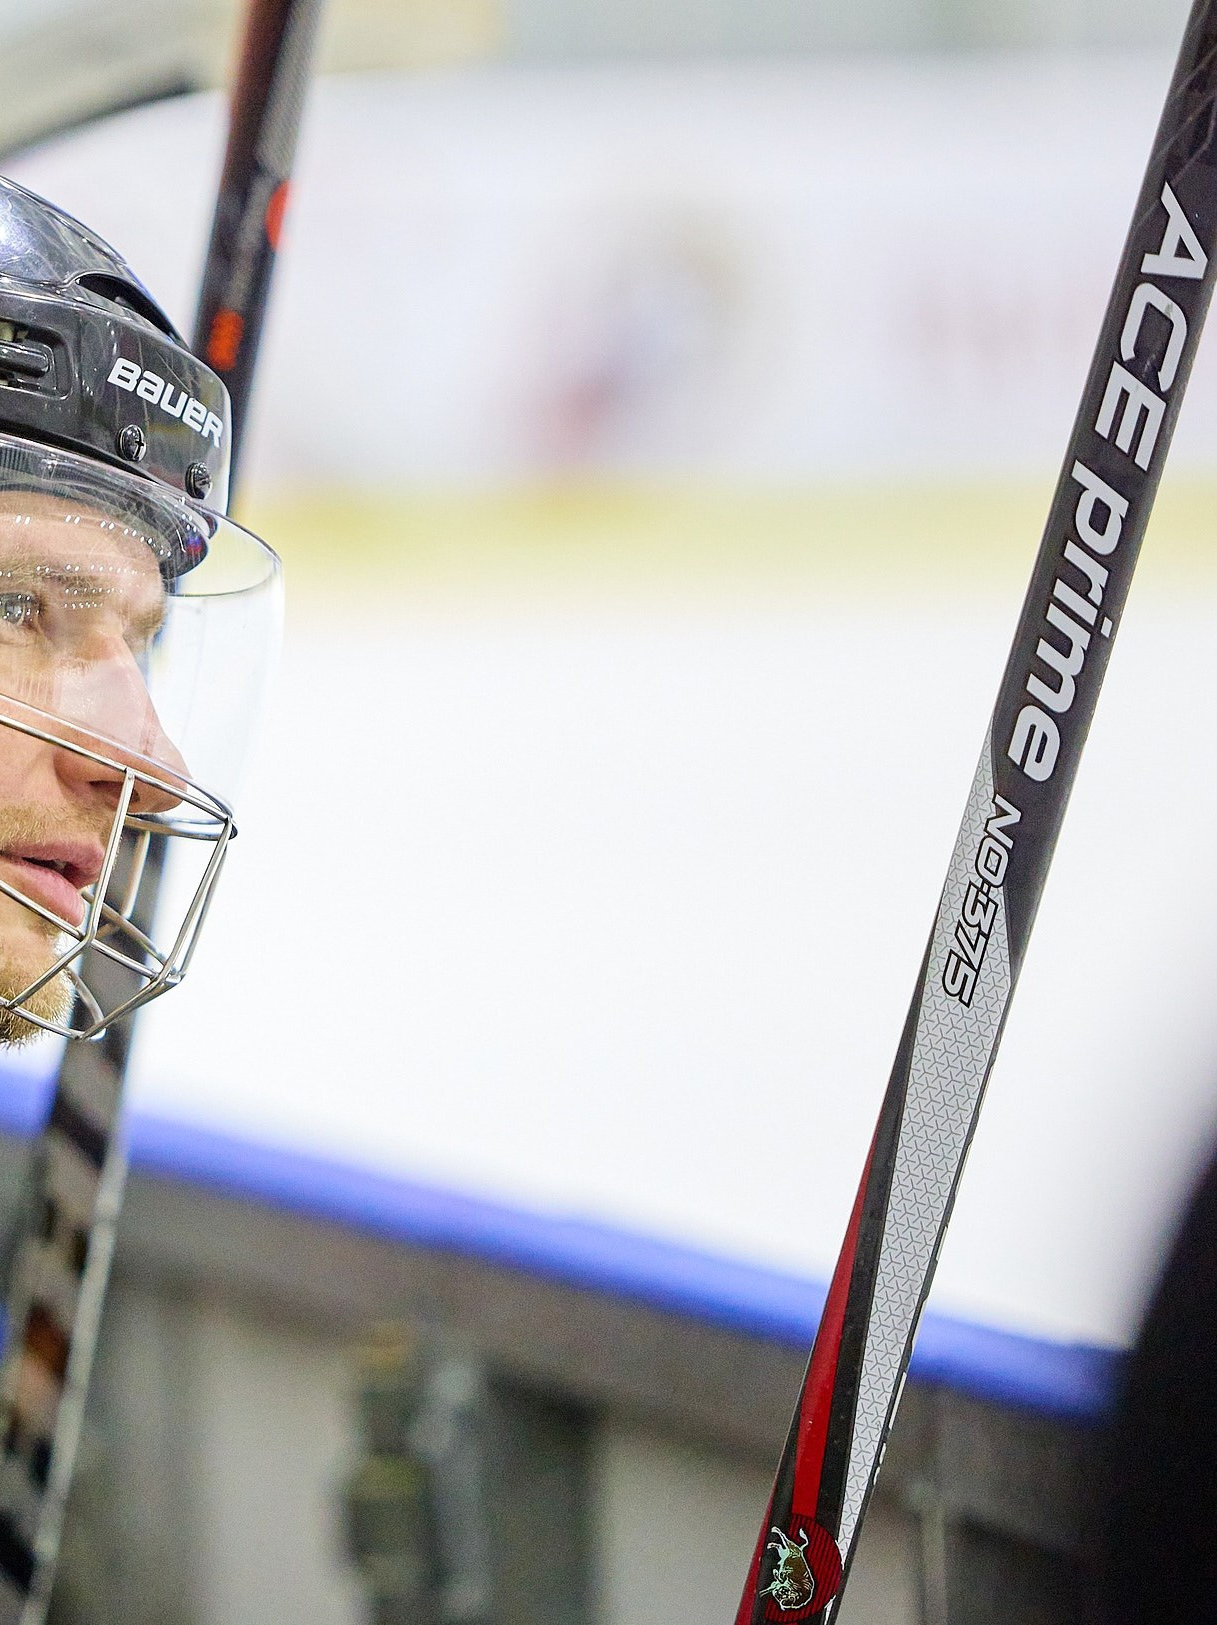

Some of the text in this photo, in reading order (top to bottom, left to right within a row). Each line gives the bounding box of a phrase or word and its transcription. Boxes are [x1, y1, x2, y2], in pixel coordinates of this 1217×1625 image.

[107, 357, 223, 448] BAUER
[1007, 181, 1208, 782] ACE prime
